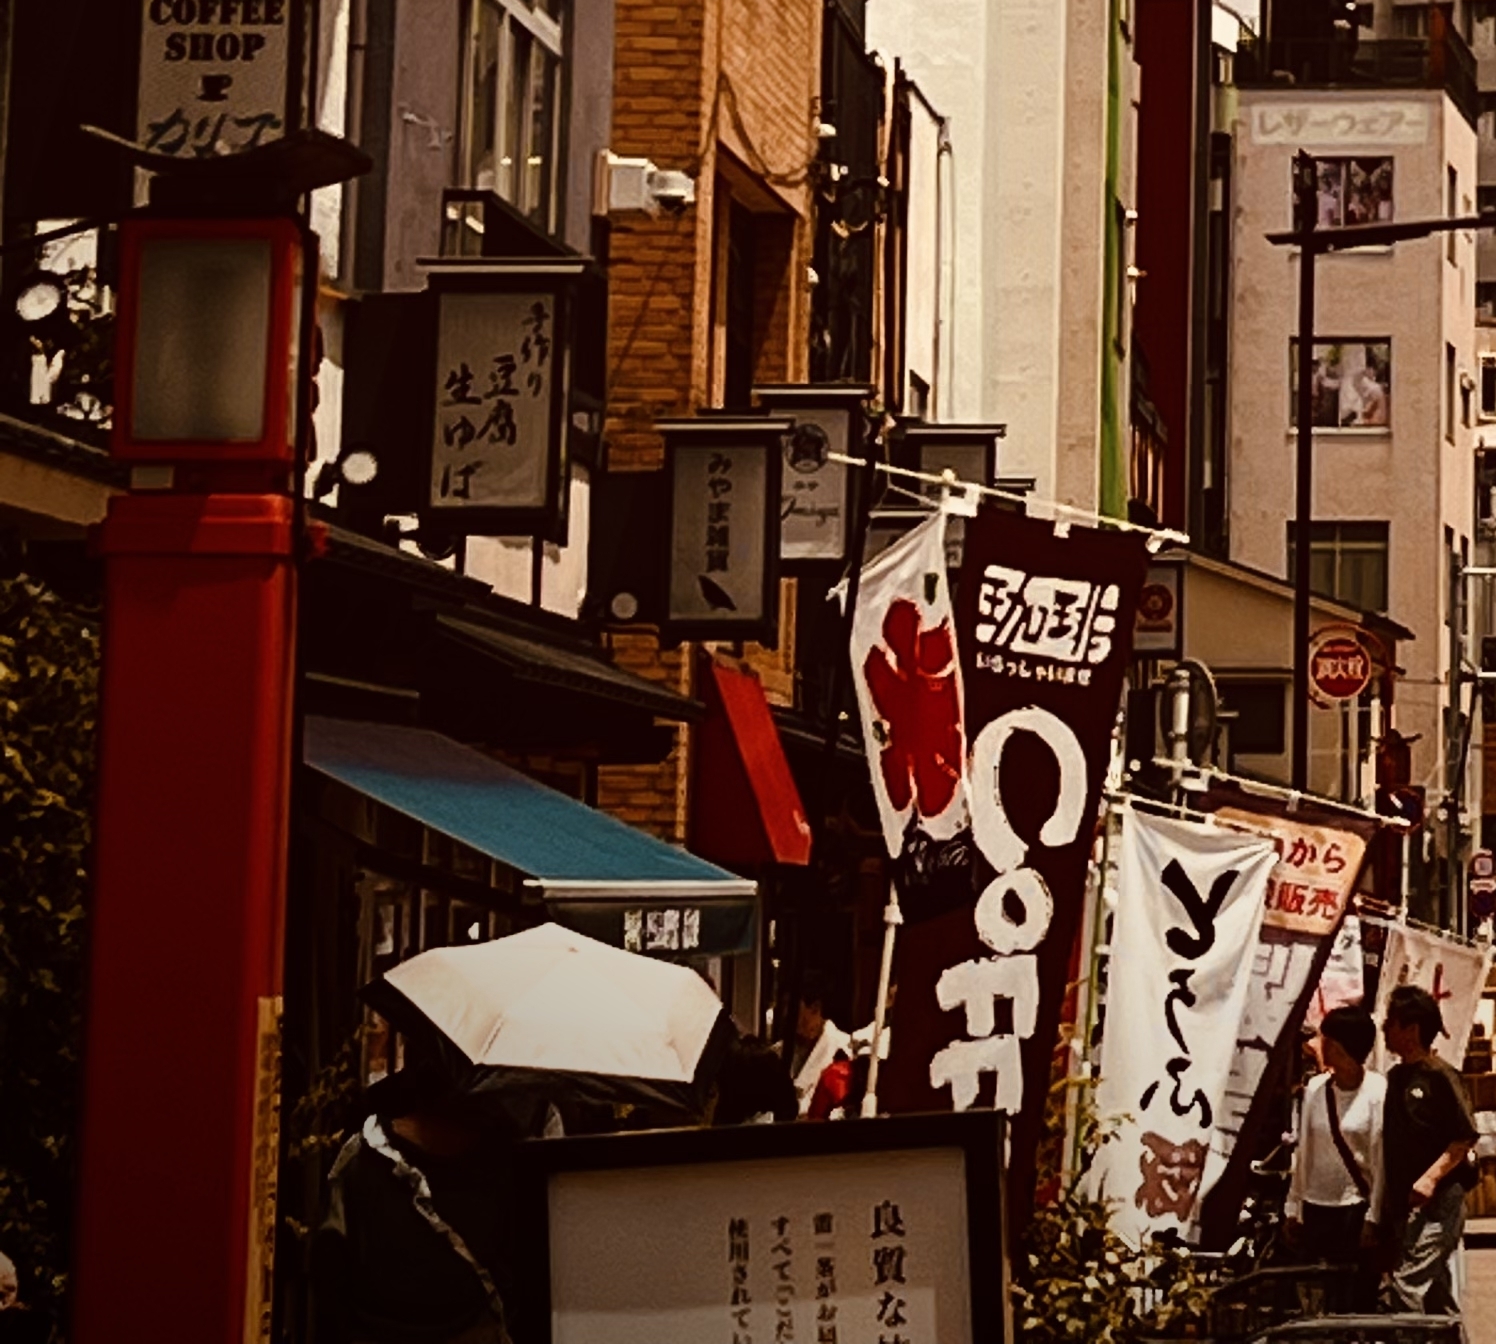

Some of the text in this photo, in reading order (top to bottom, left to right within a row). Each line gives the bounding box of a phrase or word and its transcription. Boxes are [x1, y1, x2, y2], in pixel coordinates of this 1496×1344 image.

[164, 31, 266, 61] SHOP
[440, 362, 483, 499] 生ゆば
